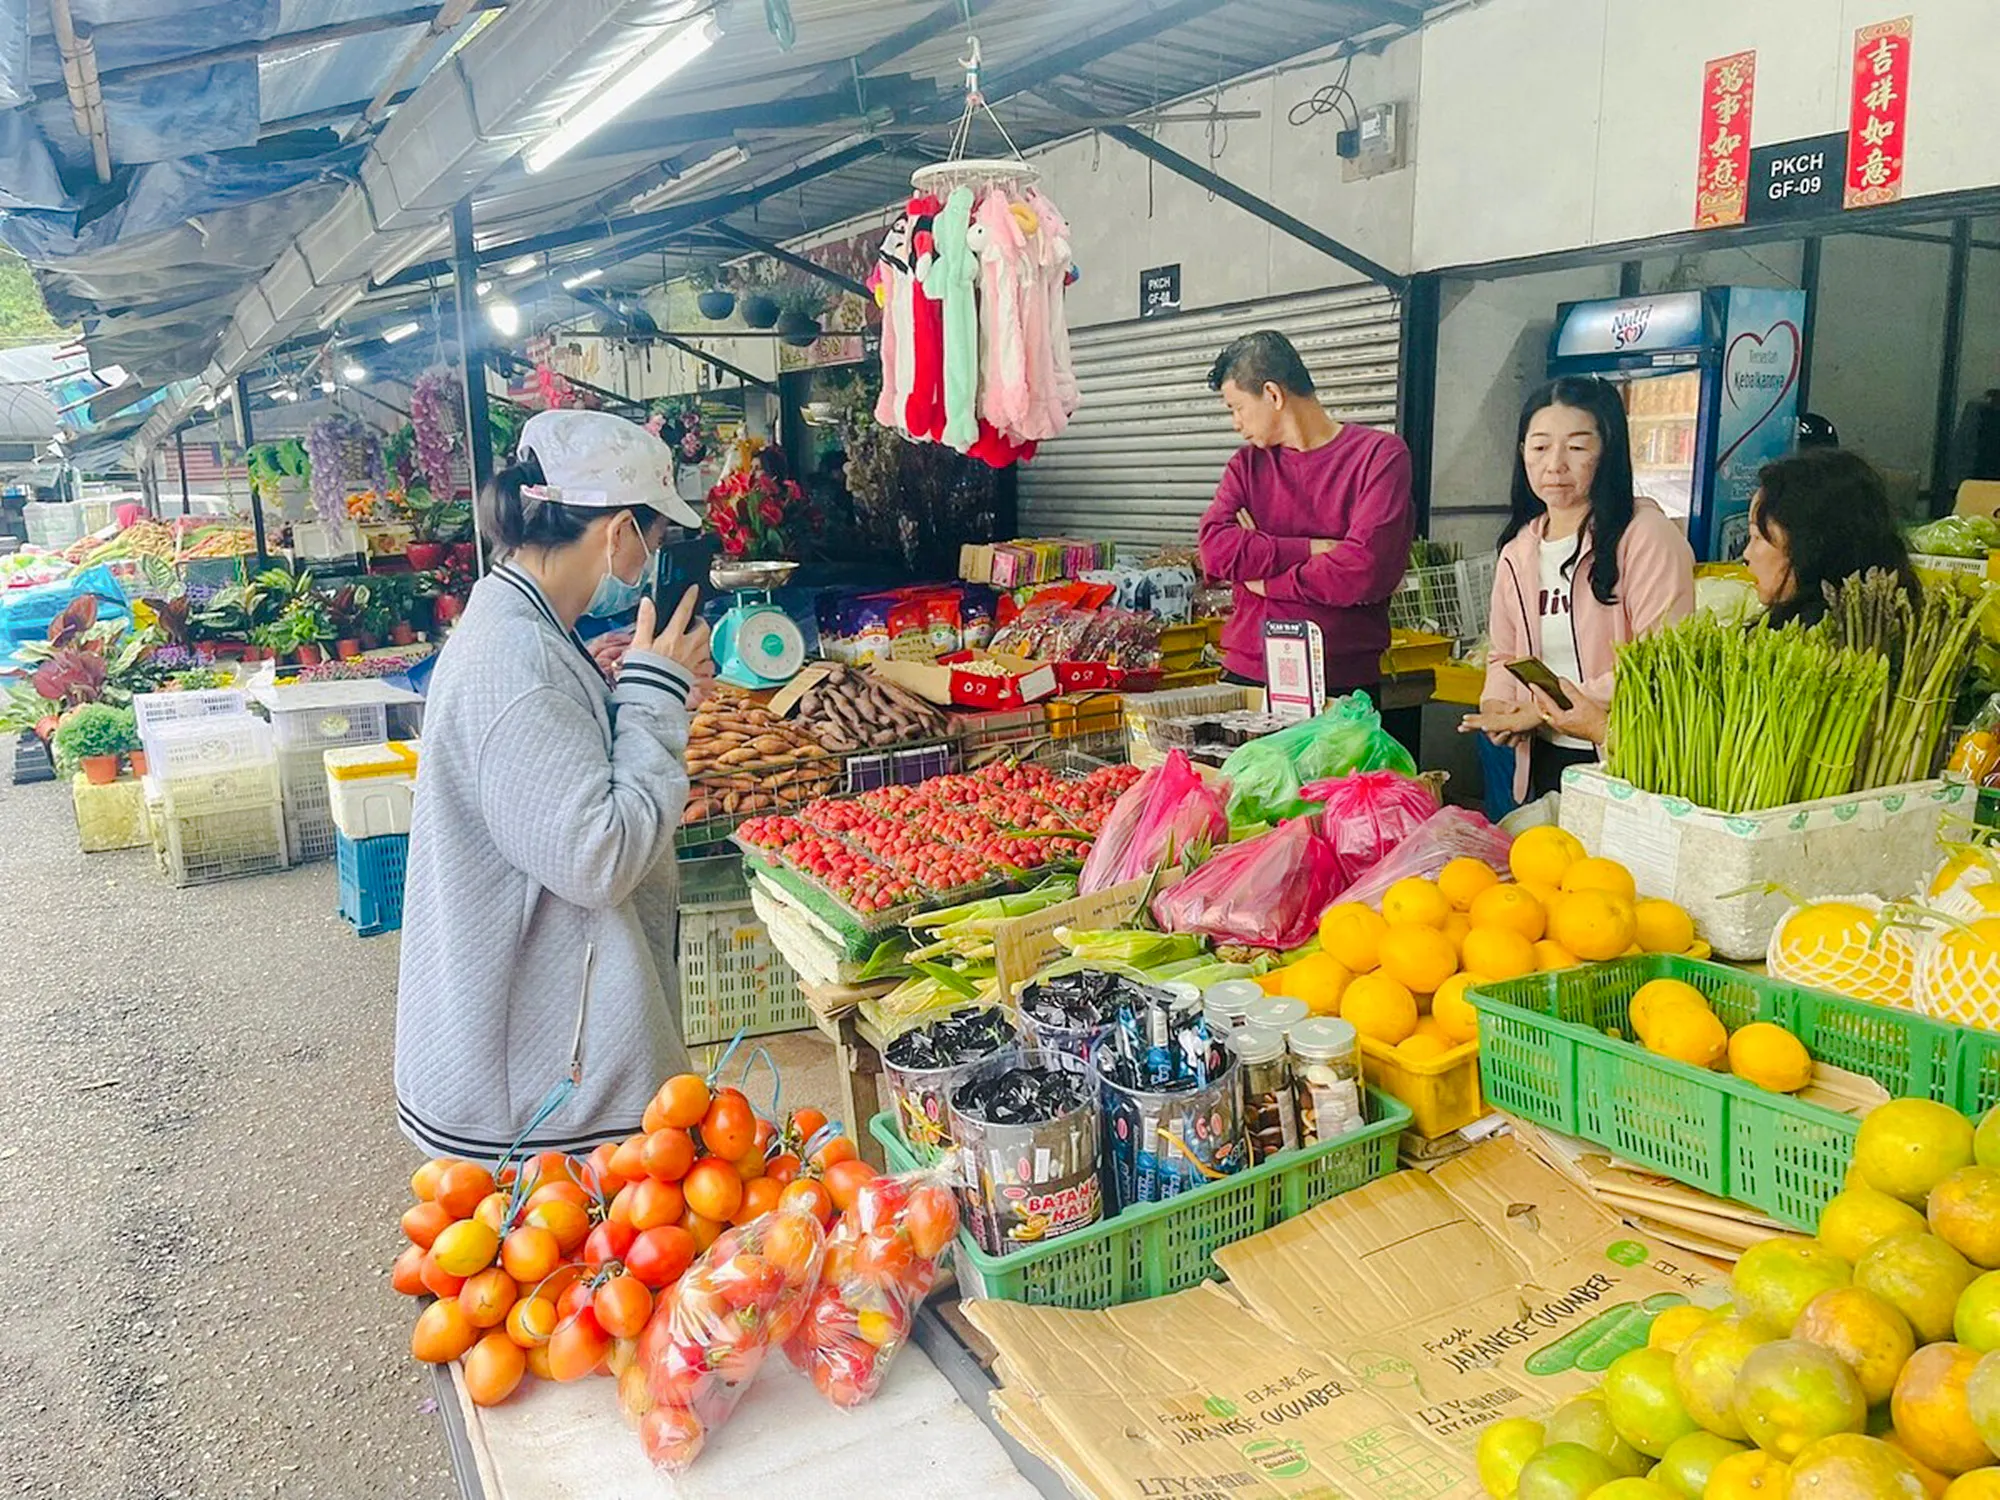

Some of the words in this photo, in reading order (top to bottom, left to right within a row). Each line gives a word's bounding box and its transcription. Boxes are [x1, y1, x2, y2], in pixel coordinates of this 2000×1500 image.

[1857, 38, 1898, 186] 吉祥如意
[1770, 152, 1824, 177] PKCH
[1769, 176, 1821, 200] GF-09
[1612, 304, 1653, 333] Nutri
[1442, 1321, 1538, 1374] JAPANESE
[1527, 1273, 1621, 1328] CUCUMBER
[1422, 1326, 1472, 1354] Fresh
[1158, 1412, 1206, 1425] Fresh
[1172, 1418, 1262, 1445] JAPANESE
[1261, 1380, 1353, 1425] CUCUMBER
[1135, 1477, 1191, 1496] LTY
